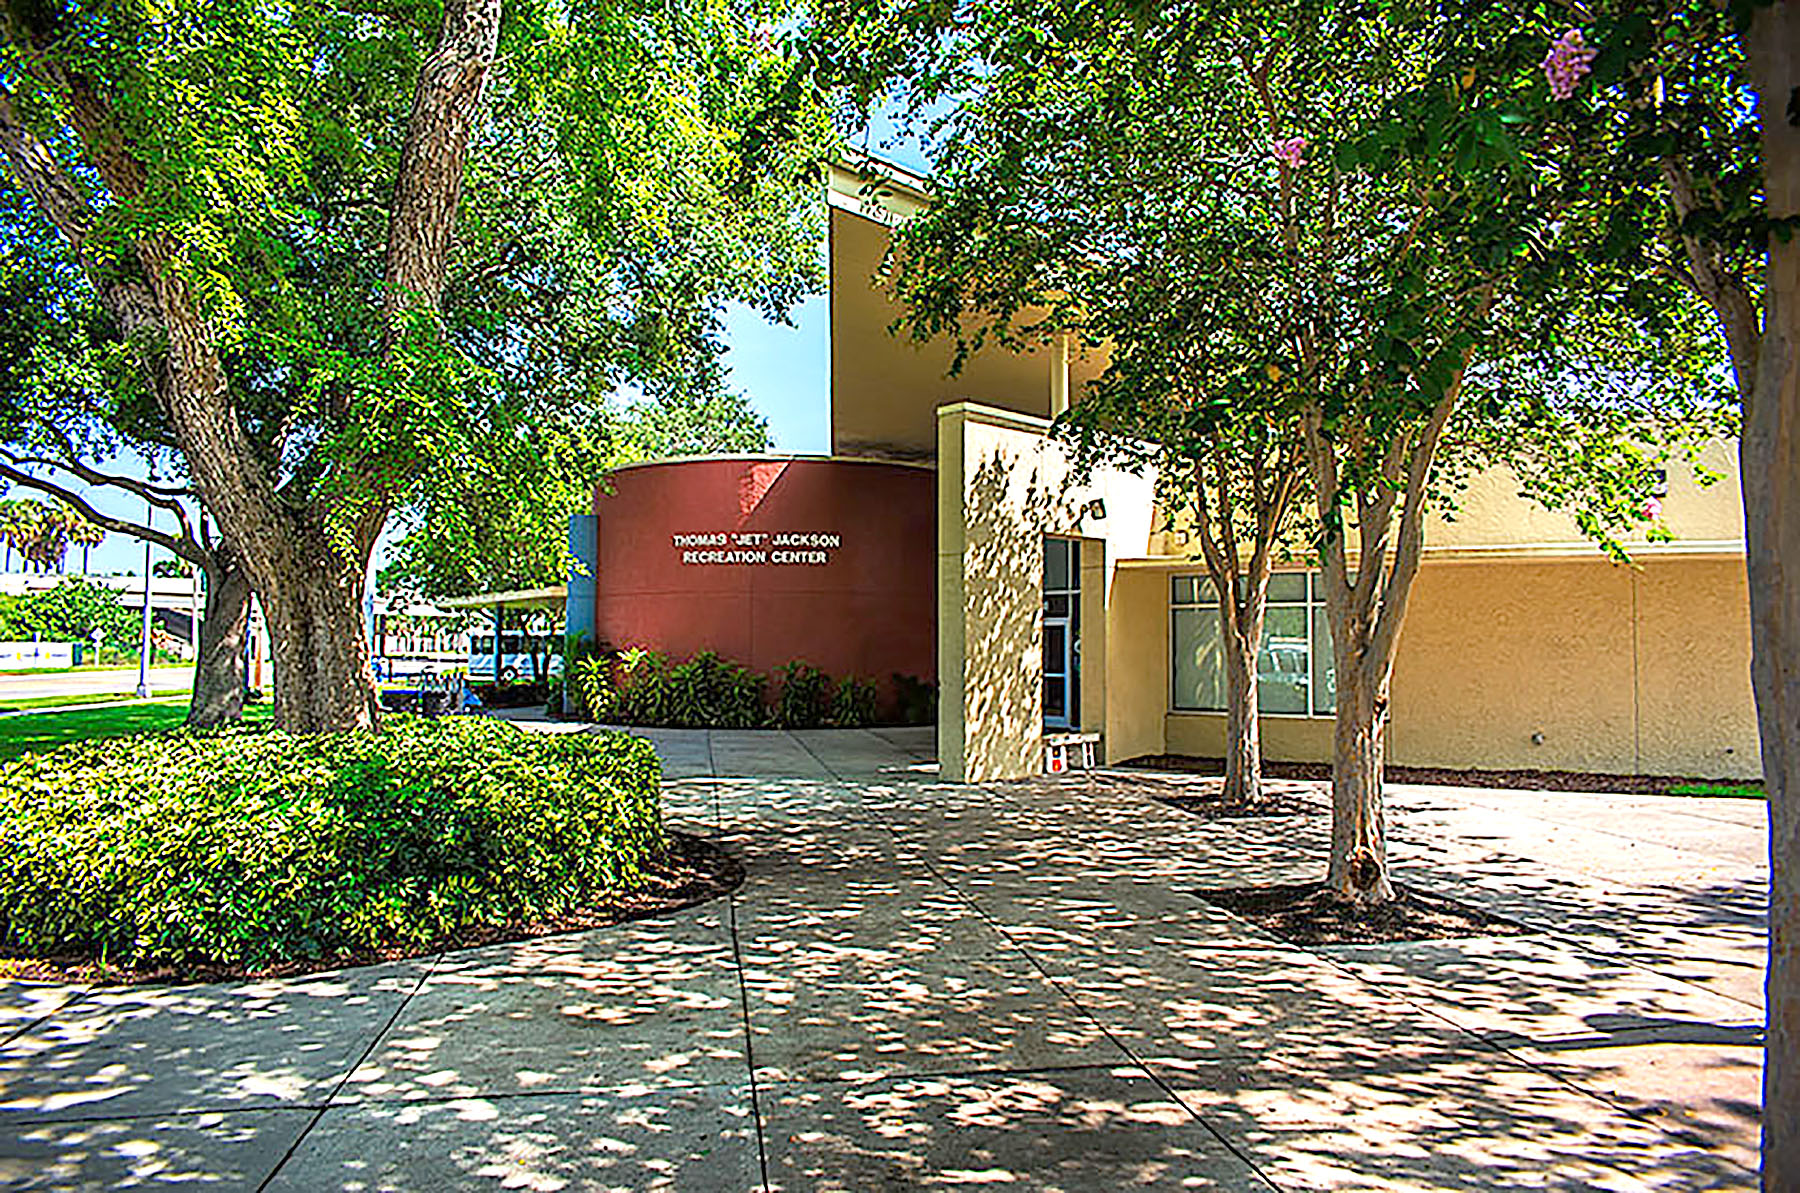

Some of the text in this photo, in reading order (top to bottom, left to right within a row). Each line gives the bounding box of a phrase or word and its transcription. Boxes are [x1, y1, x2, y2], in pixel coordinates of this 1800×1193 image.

[673, 533, 840, 547] THOMAS "JET" JACKSON
[682, 550, 827, 563] RECREATION CENTER
